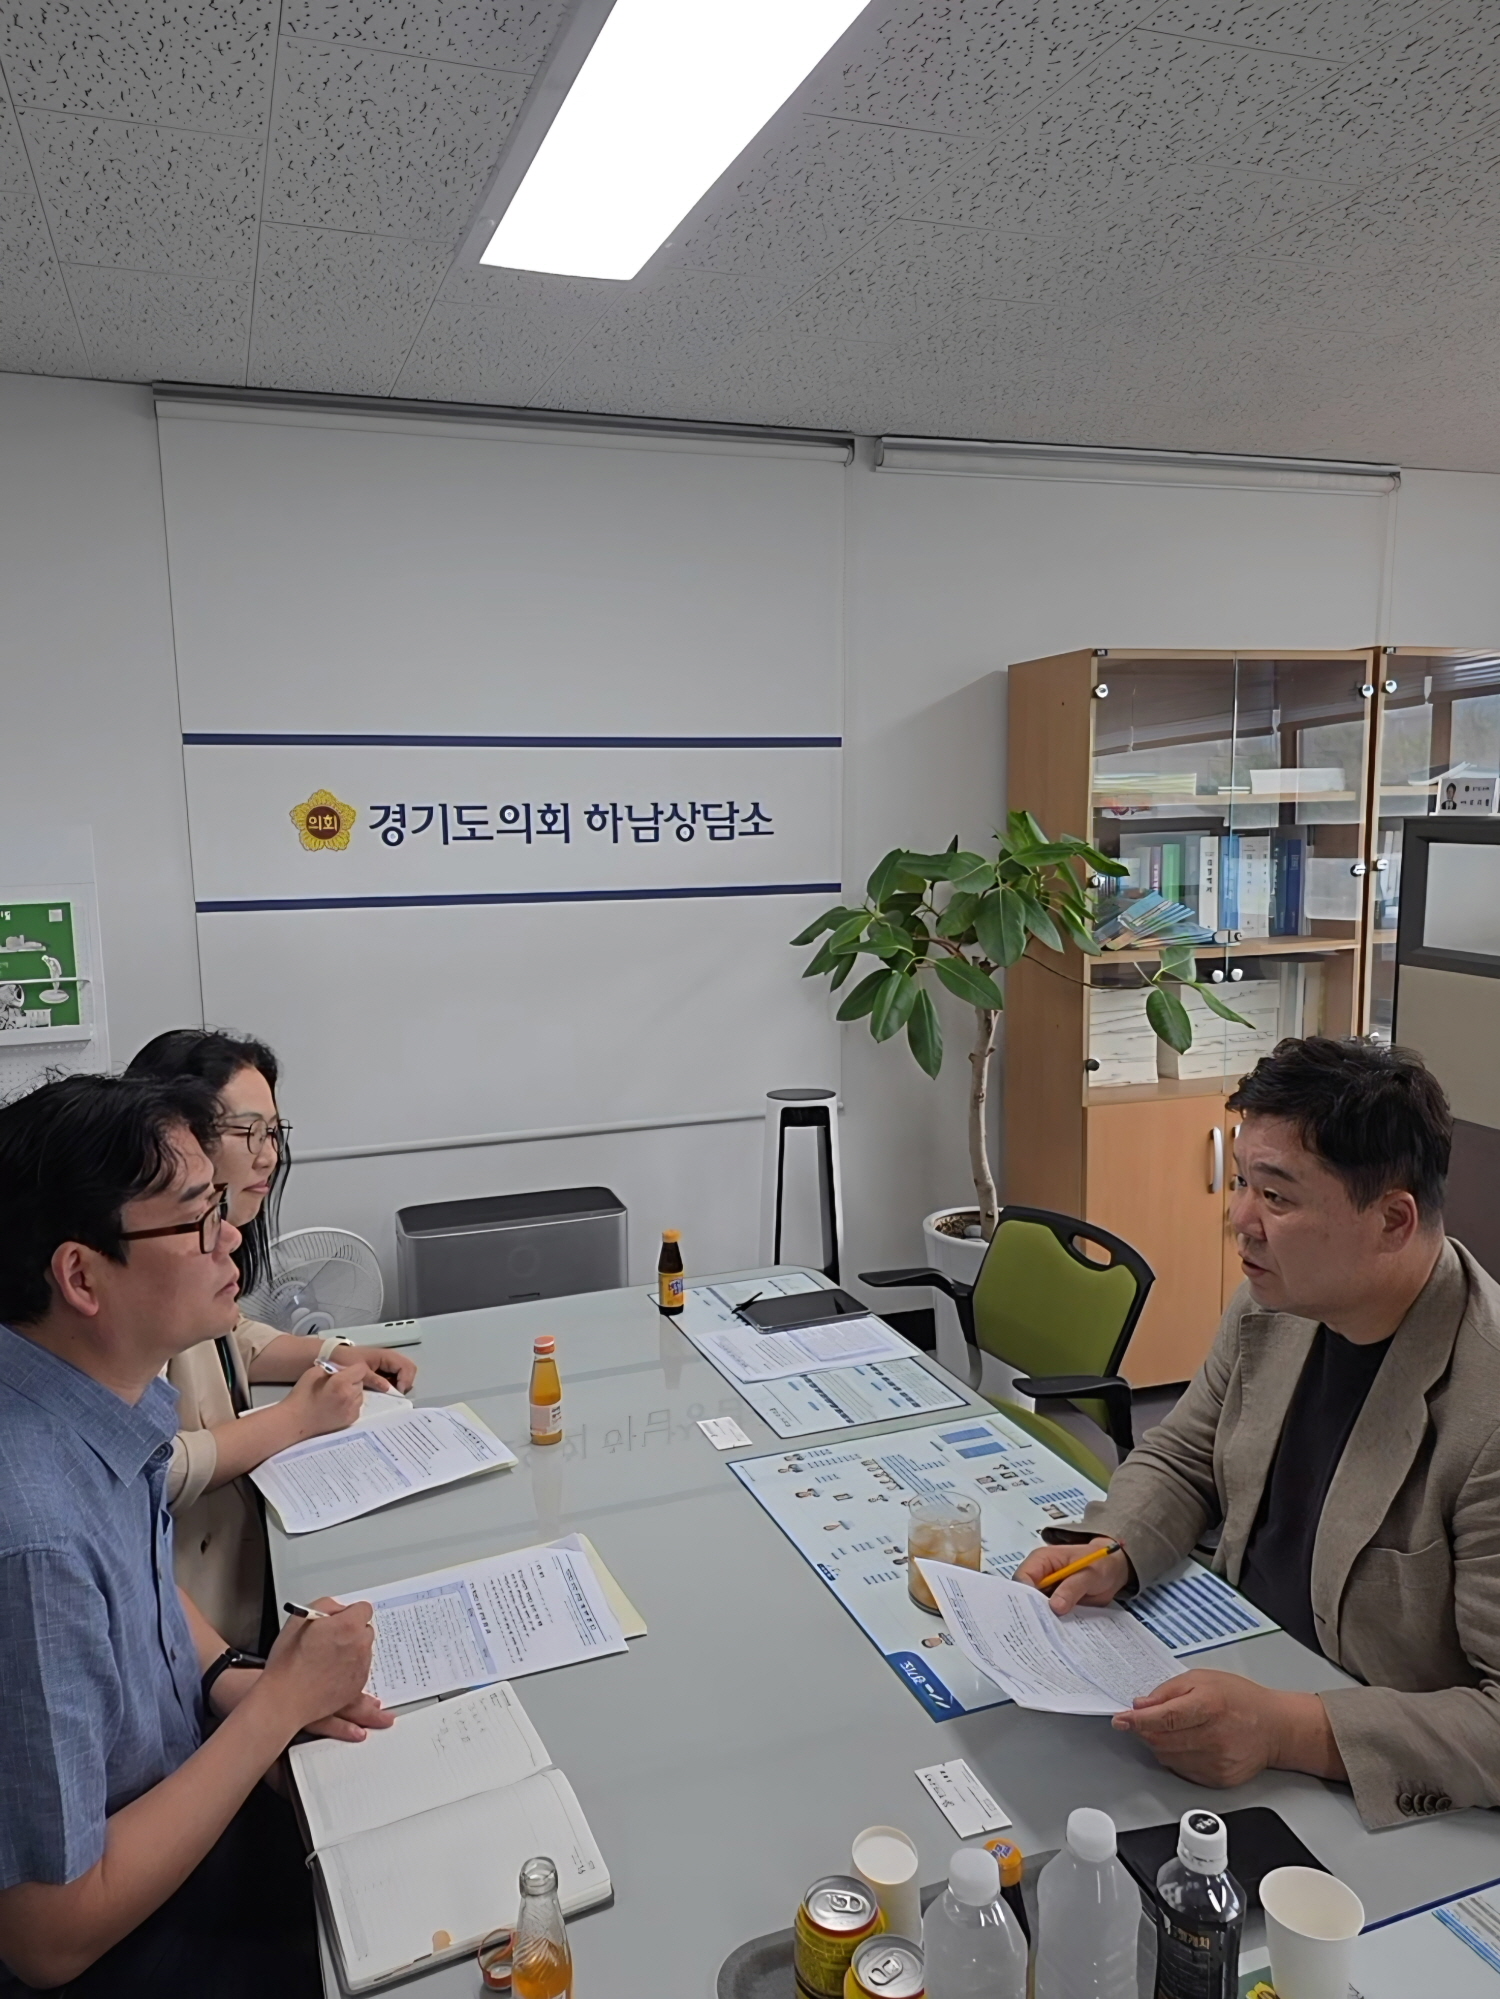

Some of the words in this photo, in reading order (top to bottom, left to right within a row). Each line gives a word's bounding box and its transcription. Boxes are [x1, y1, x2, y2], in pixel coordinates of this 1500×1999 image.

[308, 814, 338, 832] 의회
[368, 802, 572, 847] 경기도의회
[583, 800, 775, 845] 하남상담소
